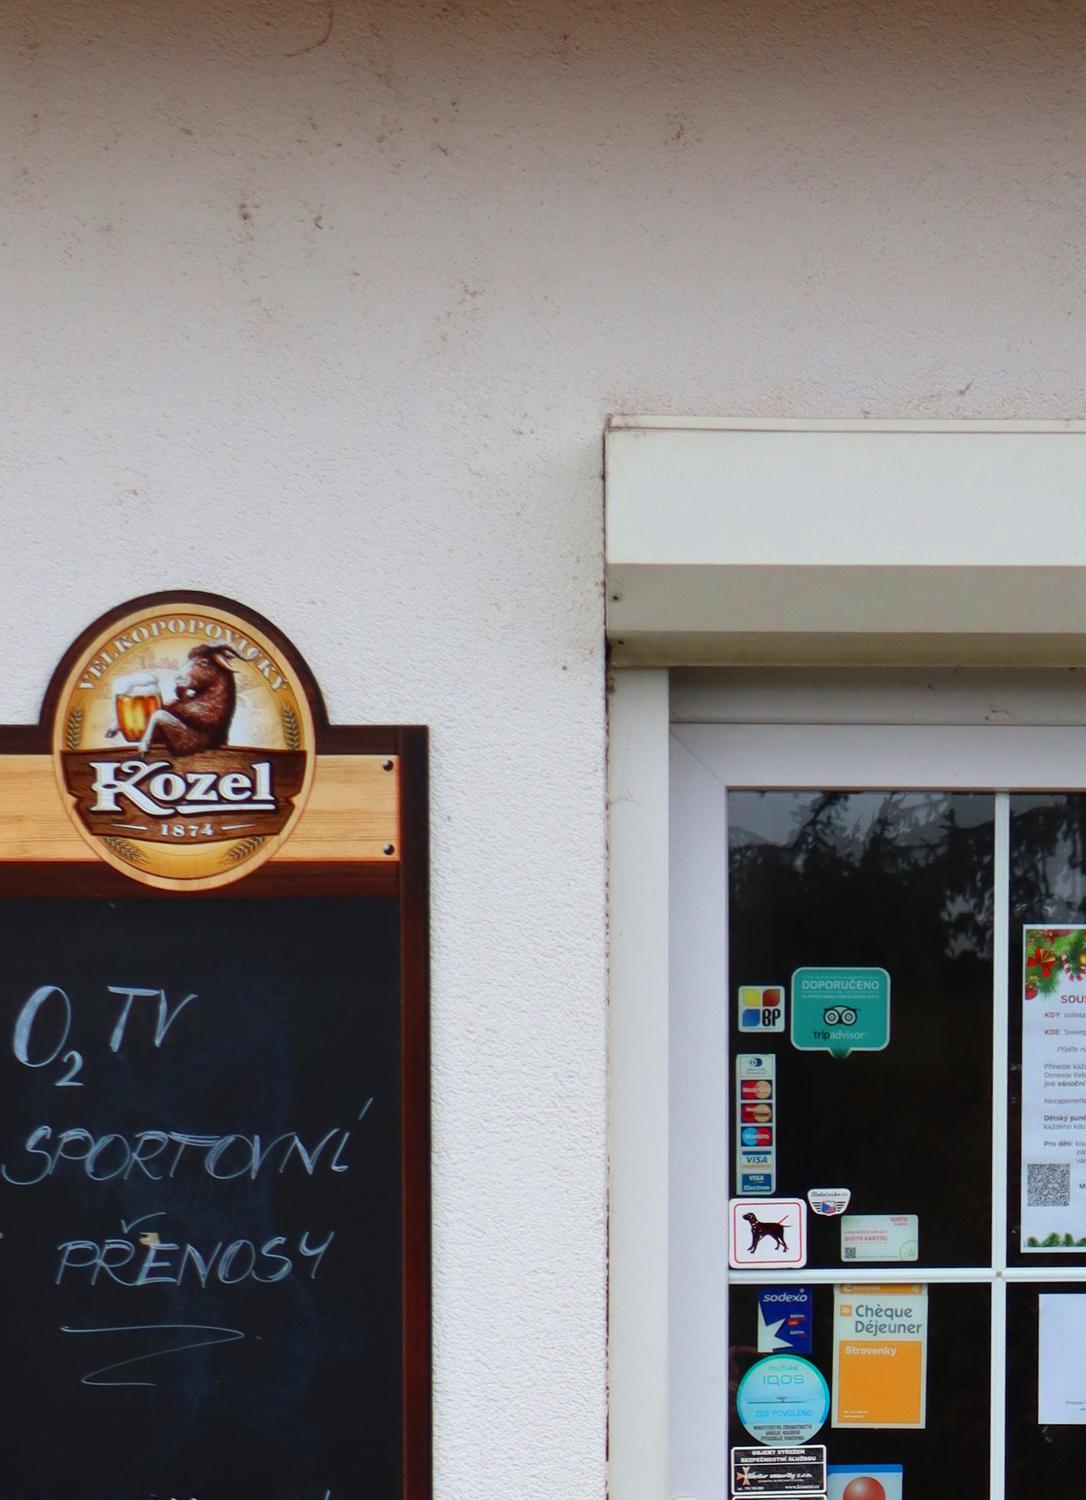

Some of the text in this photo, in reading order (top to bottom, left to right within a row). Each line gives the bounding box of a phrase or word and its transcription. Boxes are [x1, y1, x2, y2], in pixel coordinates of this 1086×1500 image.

[90, 761, 276, 816] Kozel
[161, 823, 214, 837] 1874
[802, 979, 880, 990] DOPORUČENO
[107, 985, 199, 1052] TV
[813, 1031, 865, 1041] tripadvisor
[1, 1097, 374, 1185] SPORTOVNÍ
[56, 1211, 335, 1289] PŘENOSY
[763, 1292, 808, 1302] sodexo
[855, 1304, 913, 1320] Chèque
[855, 1320, 922, 1336] Déjeuner
[845, 1345, 897, 1356] Stravenky
[763, 1374, 805, 1386] IQOS
